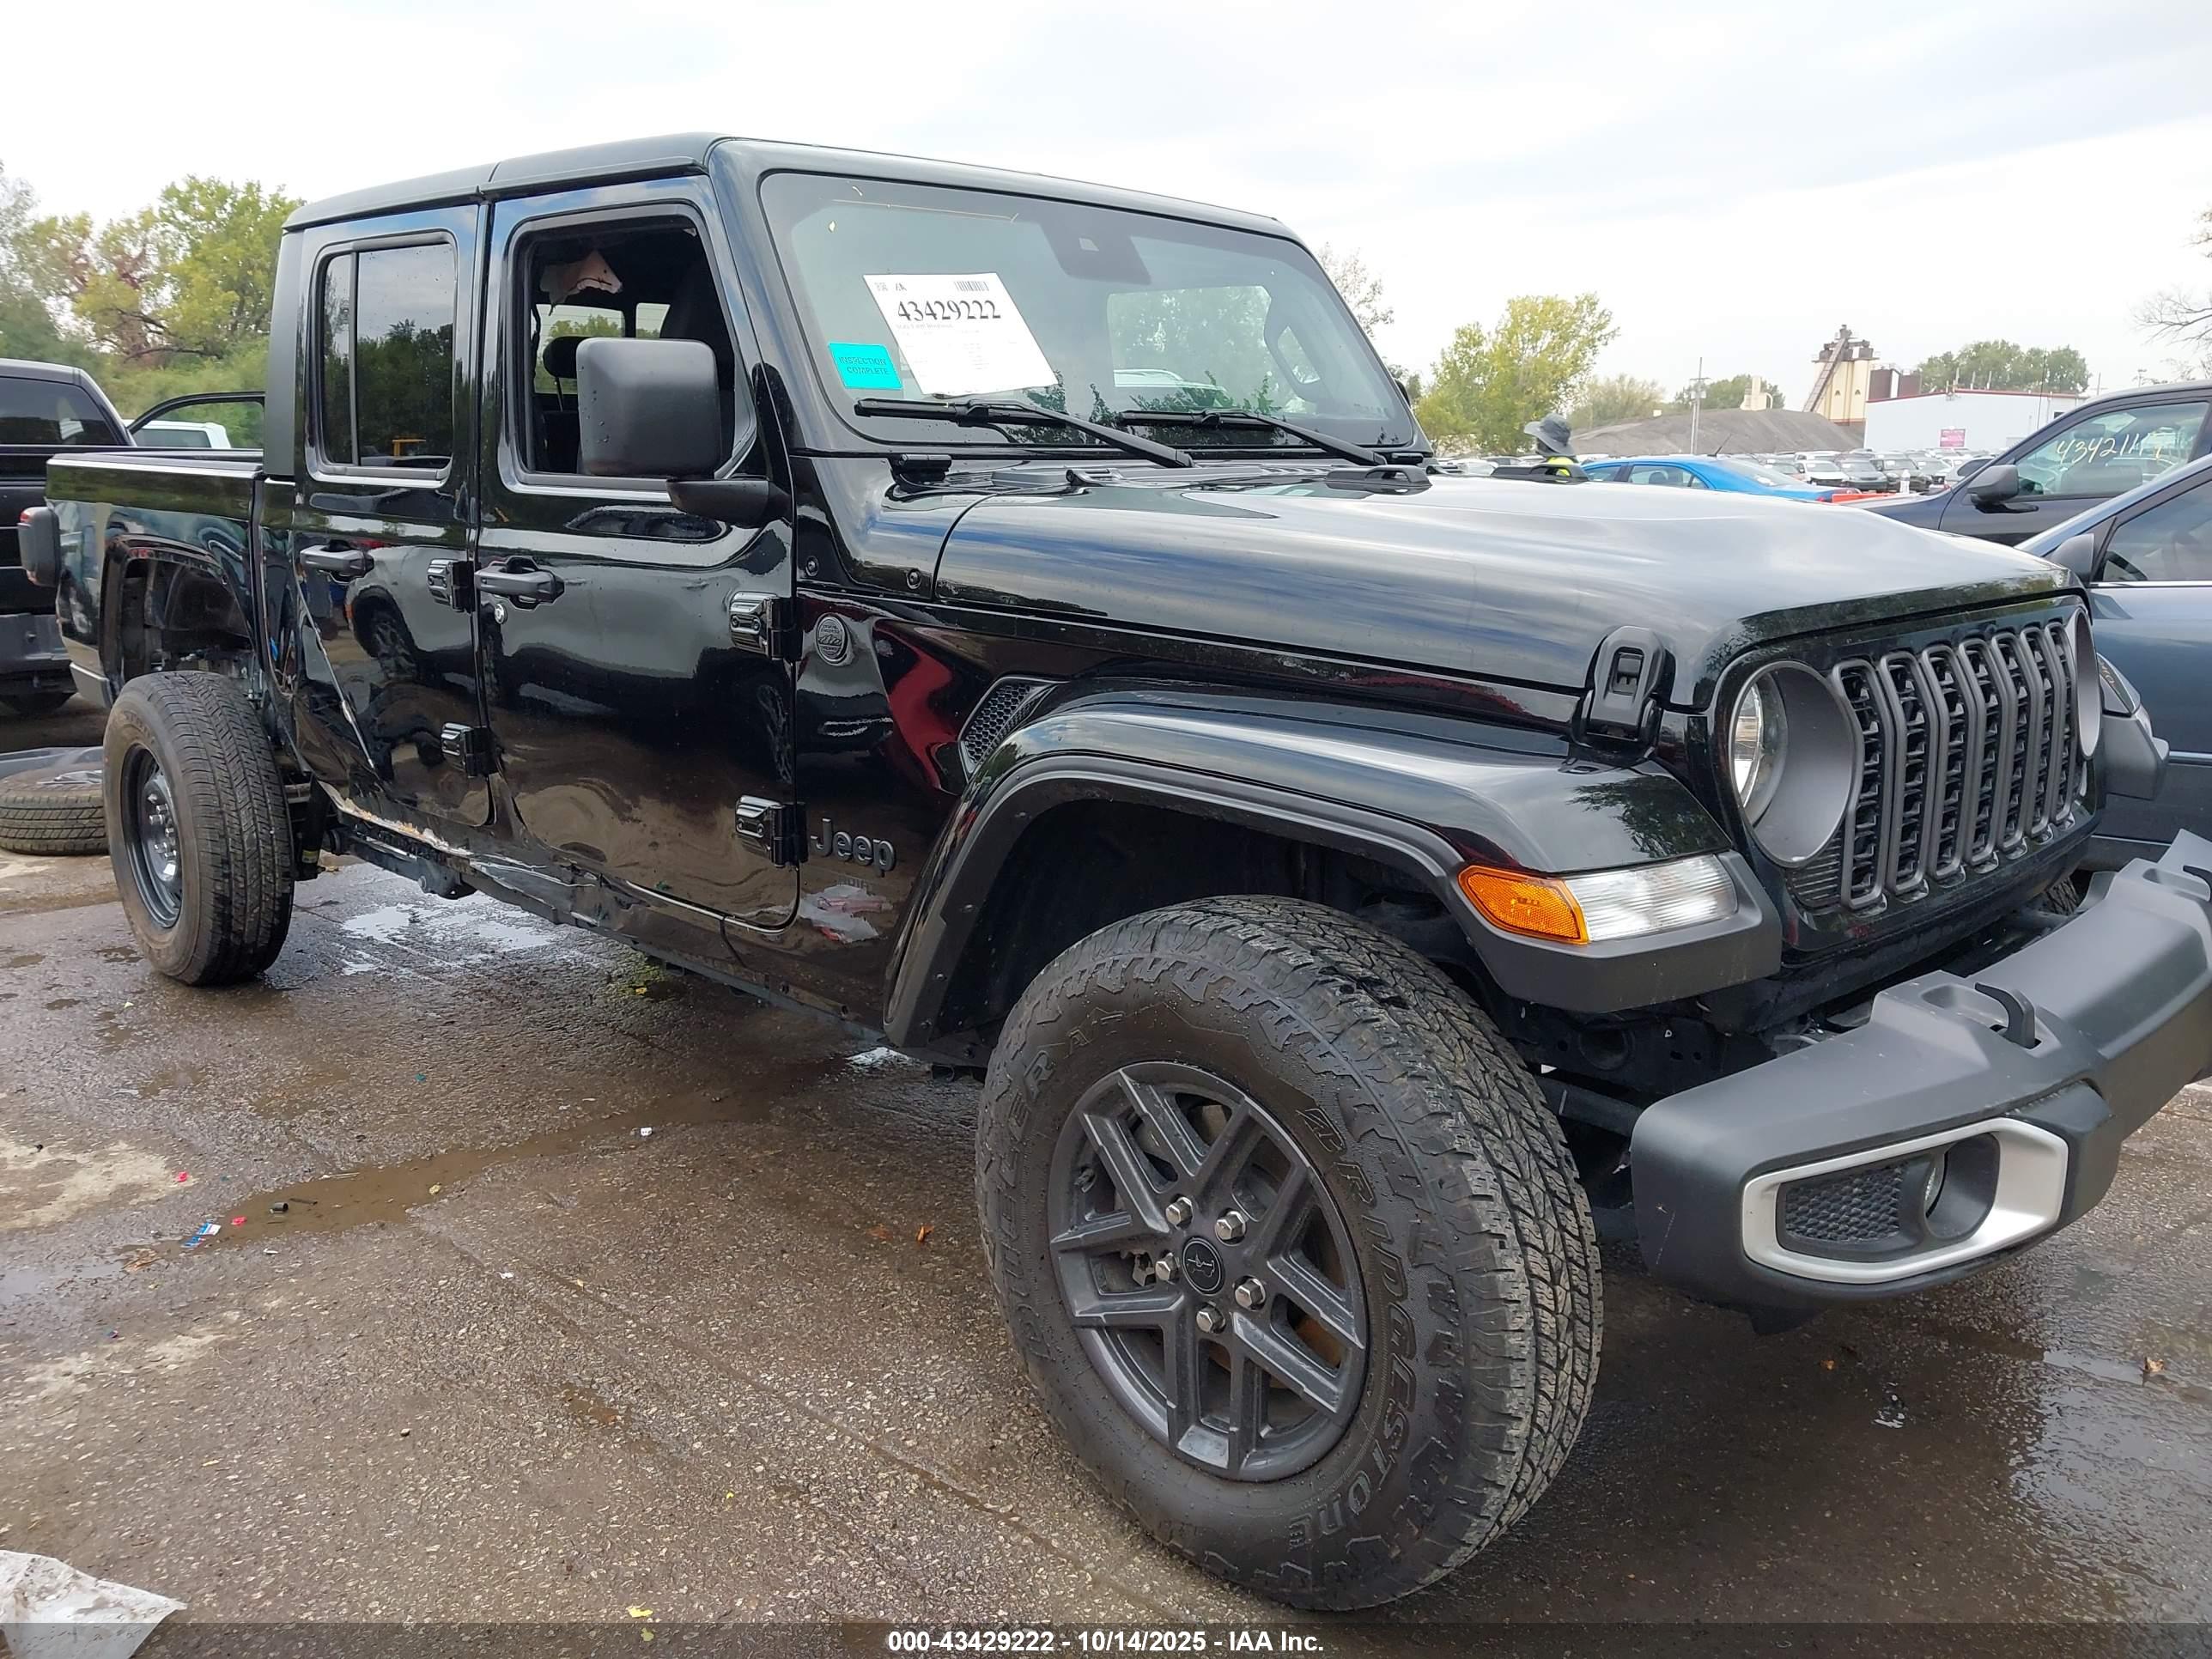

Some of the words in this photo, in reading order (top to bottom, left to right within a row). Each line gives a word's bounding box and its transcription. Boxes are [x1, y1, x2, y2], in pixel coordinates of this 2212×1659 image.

[898, 300, 1001, 321] 43429222
[847, 366, 890, 375] COMPLETE
[811, 817, 896, 877] Jeep
